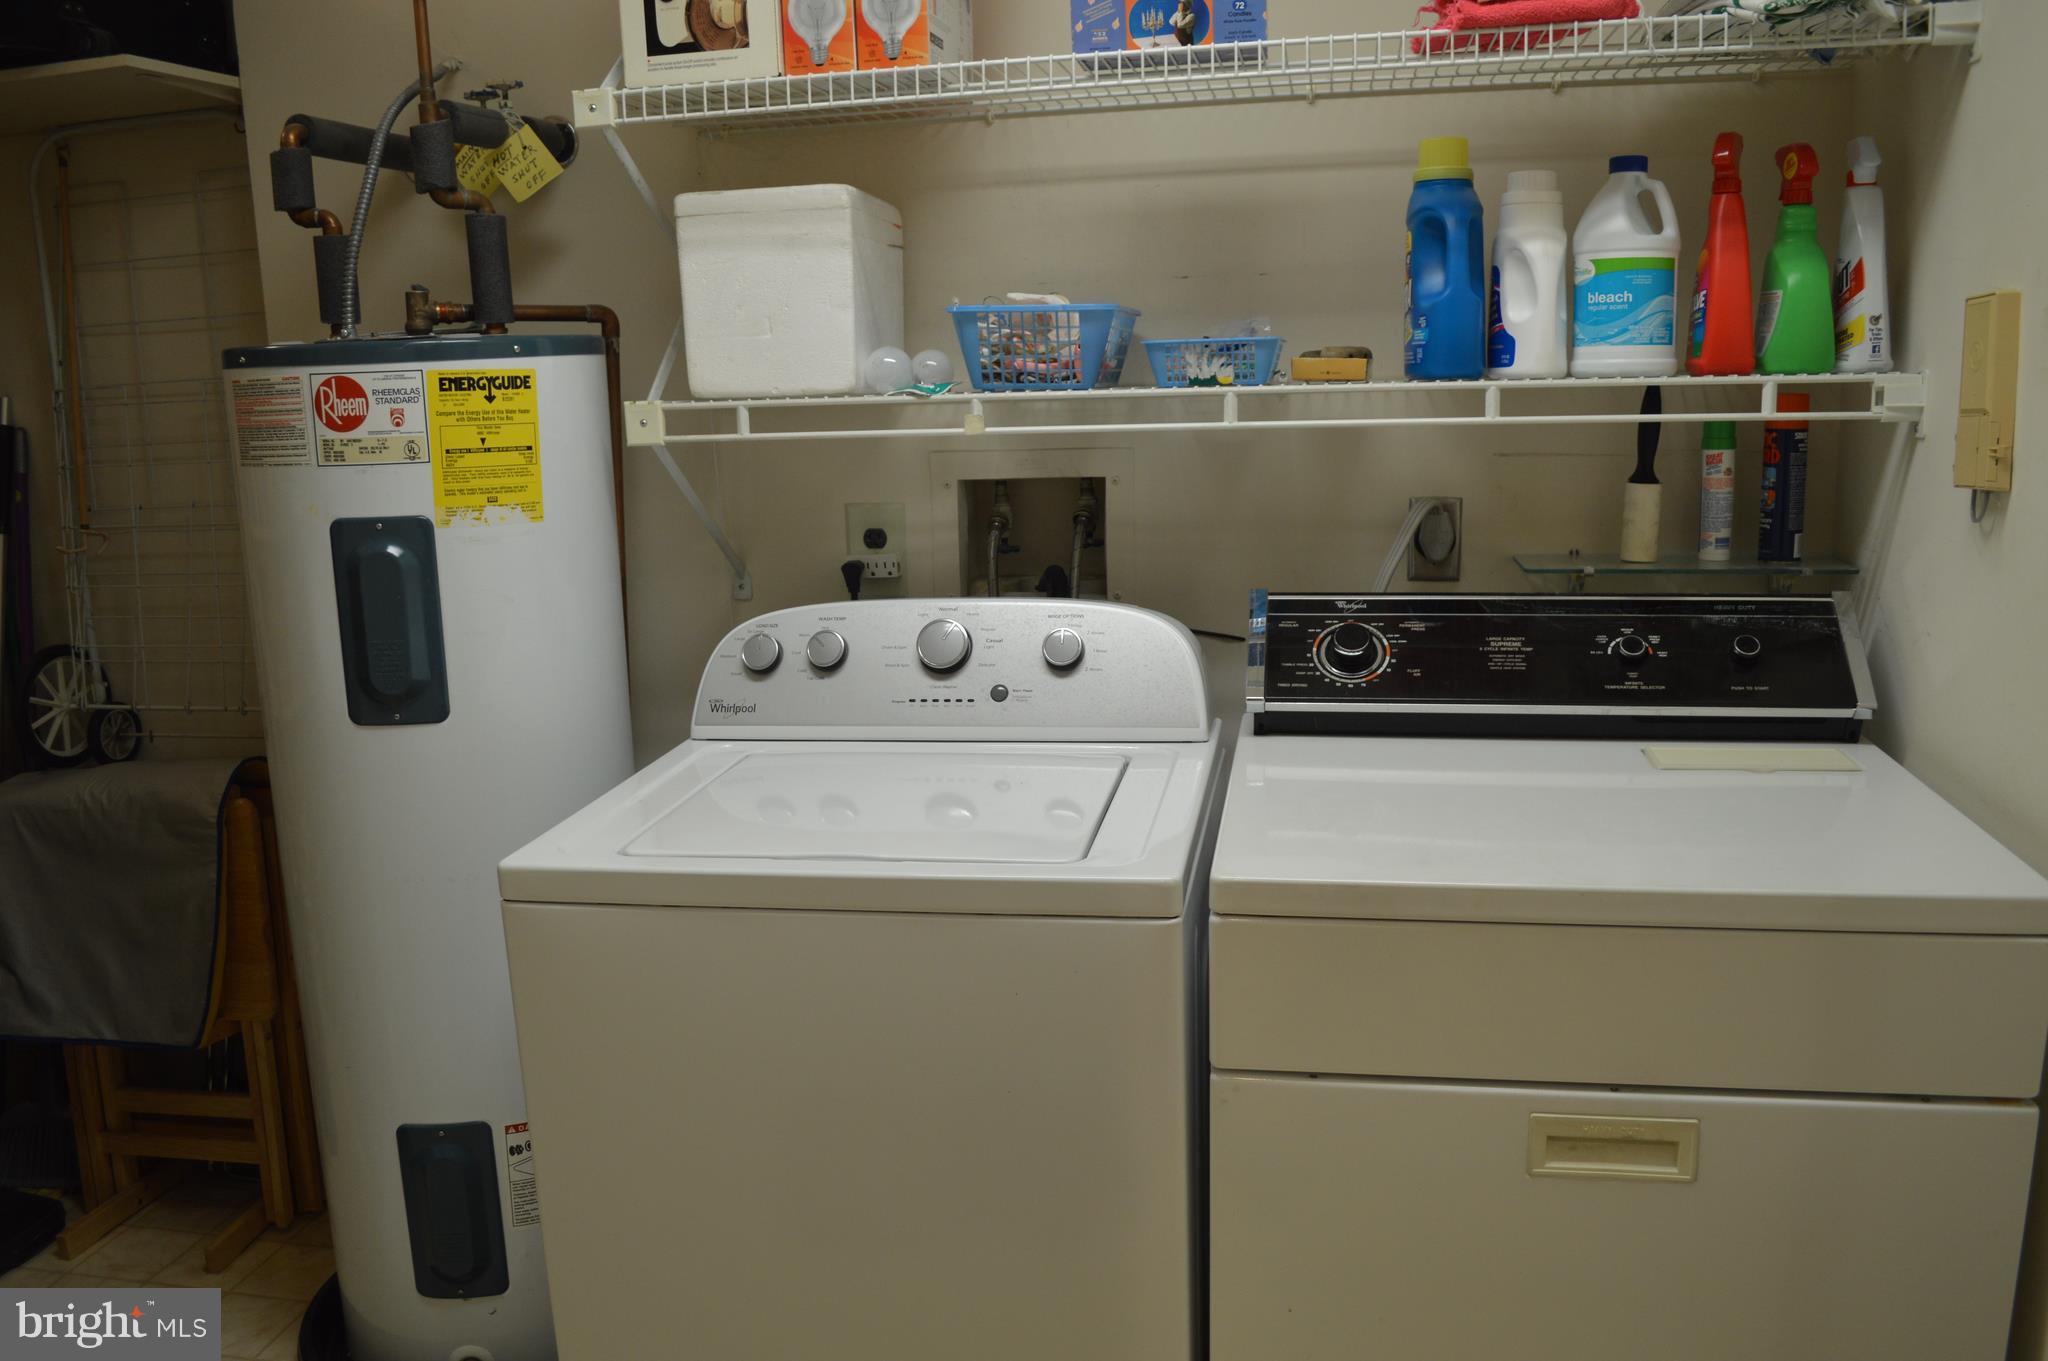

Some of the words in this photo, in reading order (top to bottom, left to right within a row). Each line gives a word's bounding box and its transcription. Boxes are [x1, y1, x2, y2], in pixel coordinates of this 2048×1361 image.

[1235, 1, 1245, 10] 72
[492, 144, 513, 168] HOT
[512, 158, 538, 184] SHUT
[1588, 291, 1633, 304] bleach
[438, 375, 531, 394] ENERGYGUIDE
[372, 387, 420, 397] RHEEMGLAS
[319, 378, 368, 425] Rheem
[375, 396, 419, 405] STANDARD
[1335, 600, 1367, 609] Whirlpool
[710, 703, 756, 716] Whirlpool
